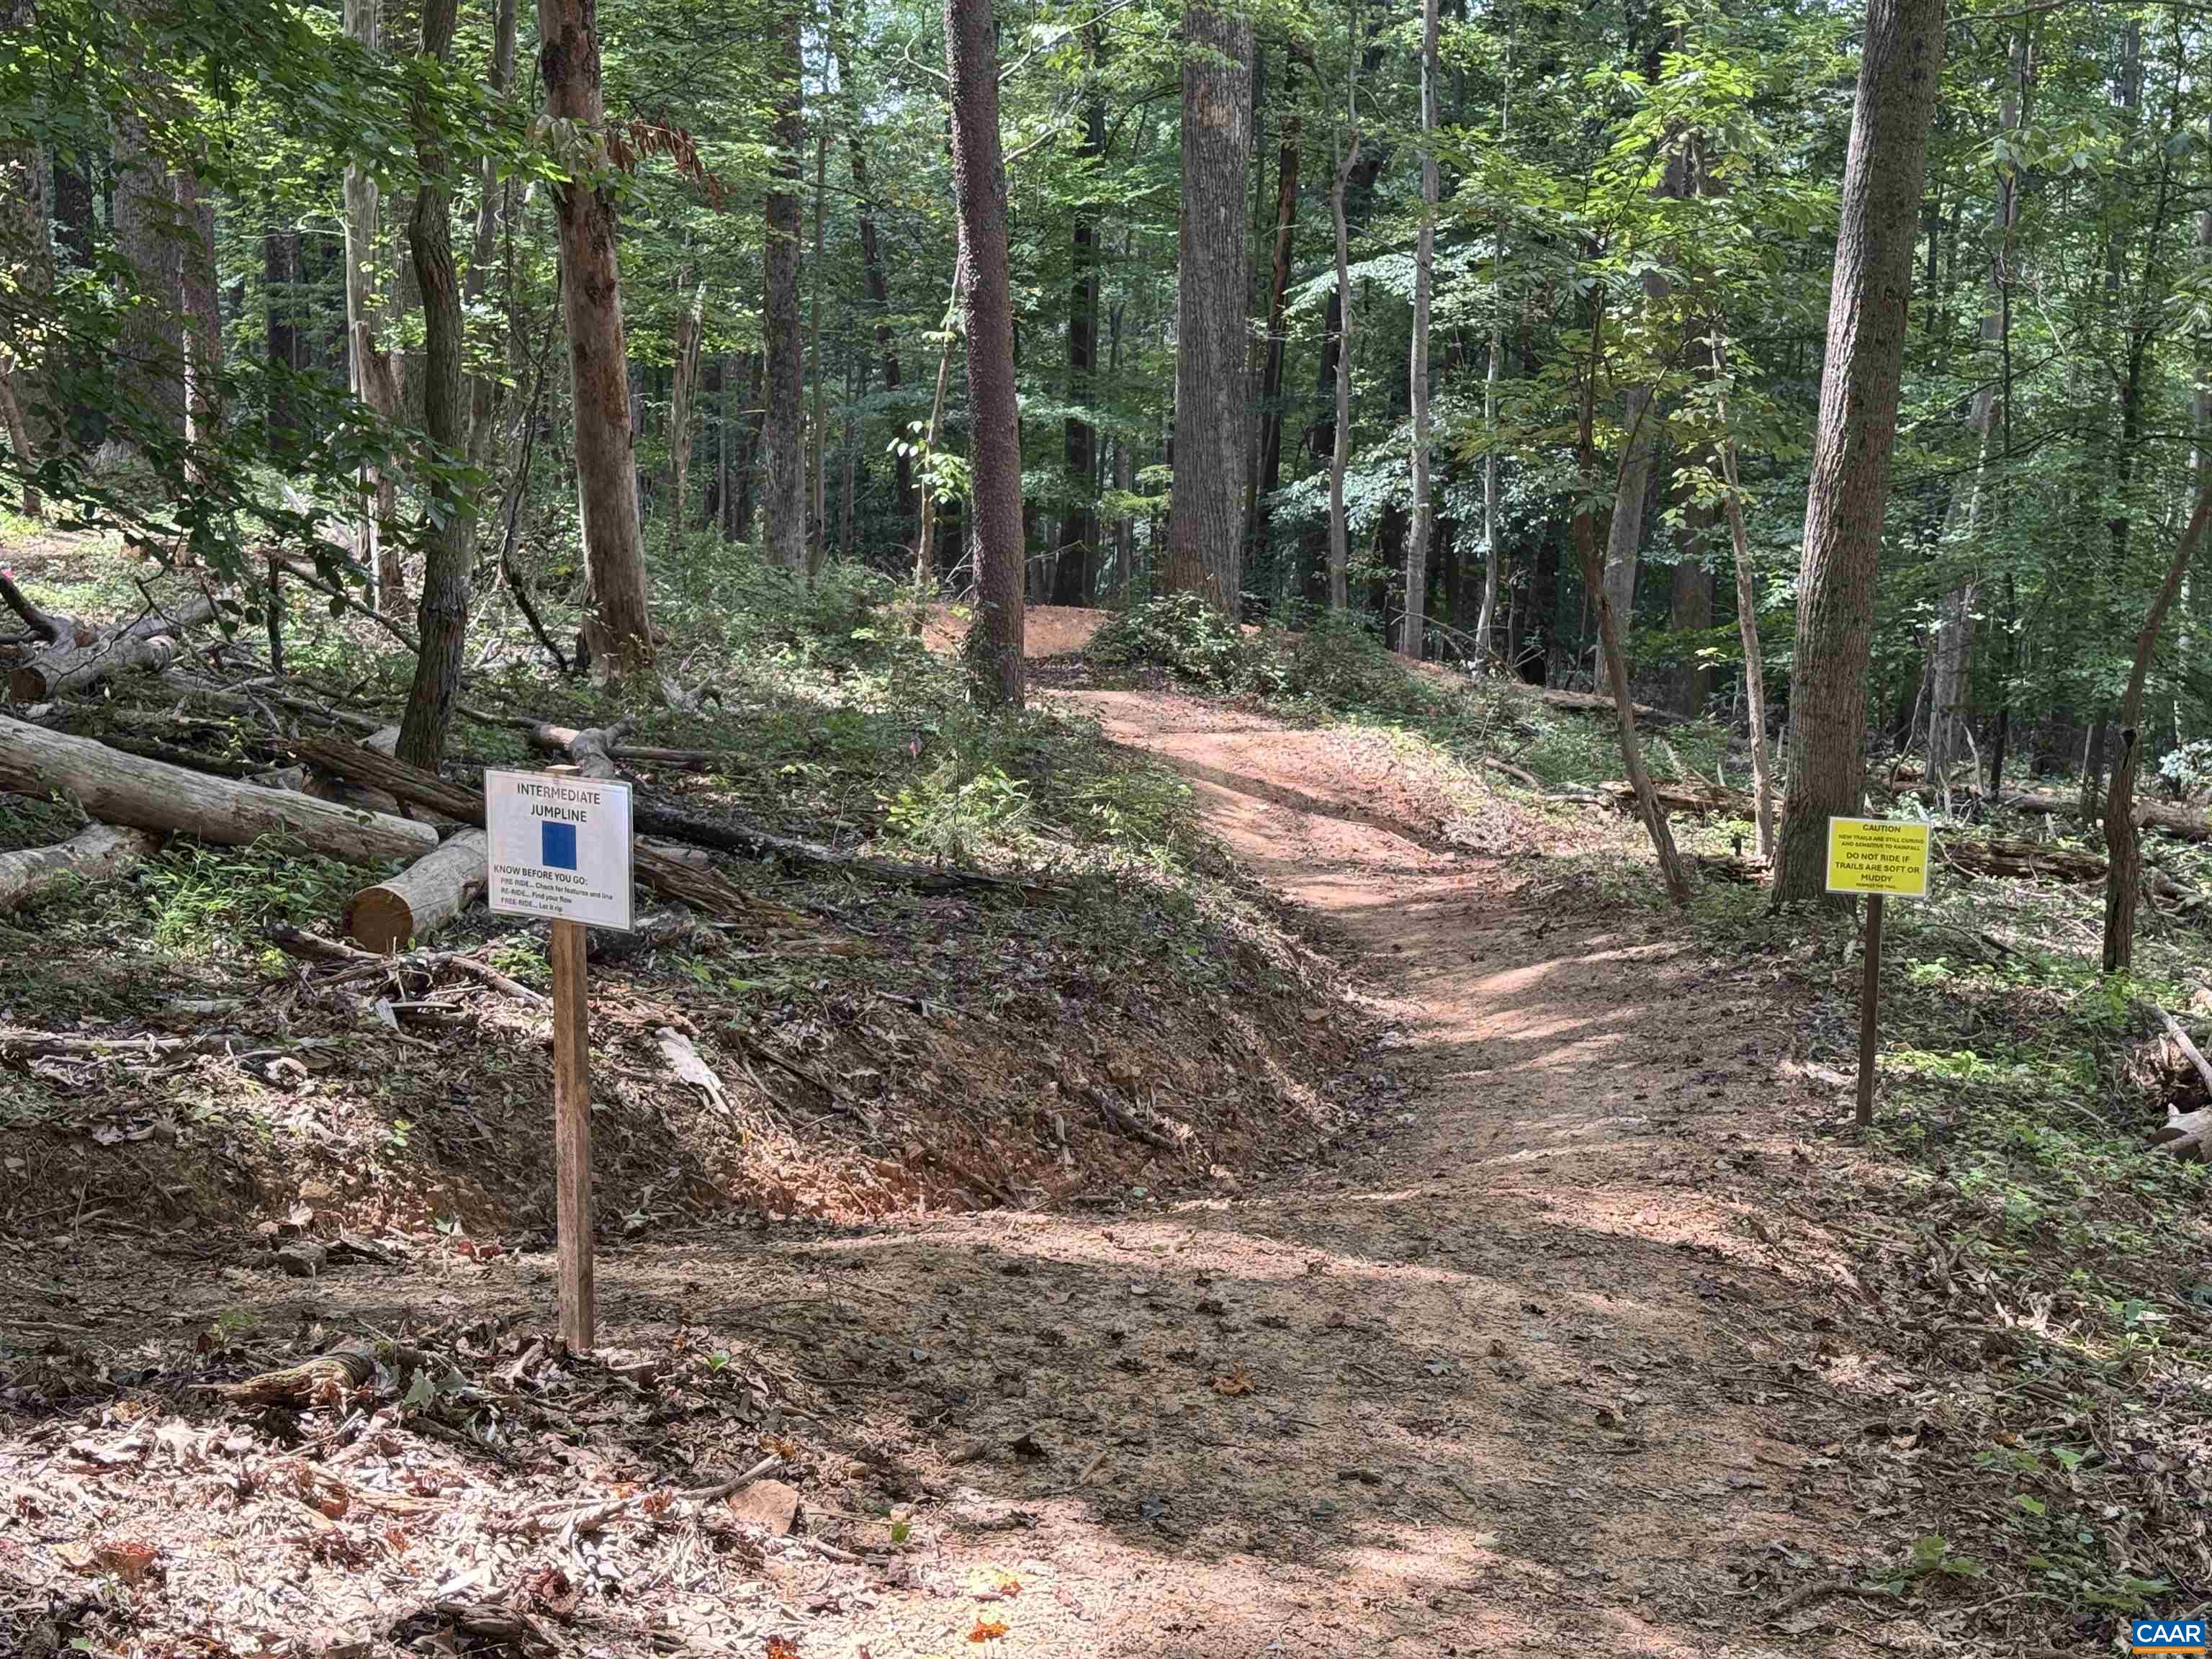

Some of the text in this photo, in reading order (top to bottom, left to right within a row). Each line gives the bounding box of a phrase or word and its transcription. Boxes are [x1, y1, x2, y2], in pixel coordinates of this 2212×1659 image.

[517, 783, 601, 804] INTERMEDIATE
[530, 804, 587, 822] JUMPLINE
[1862, 824, 1901, 832] CAUTION
[1880, 854, 1899, 863] RIDE
[1835, 862, 1863, 871] TRAILS
[1865, 863, 1882, 872] ARE
[1884, 865, 1905, 873] SOFT
[494, 864, 588, 886] KNOW BEFORE YOU GO:
[1861, 873, 1893, 882] MUDDY
[536, 882, 554, 891] Check
[565, 886, 588, 896] features
[559, 895, 572, 904] flow
